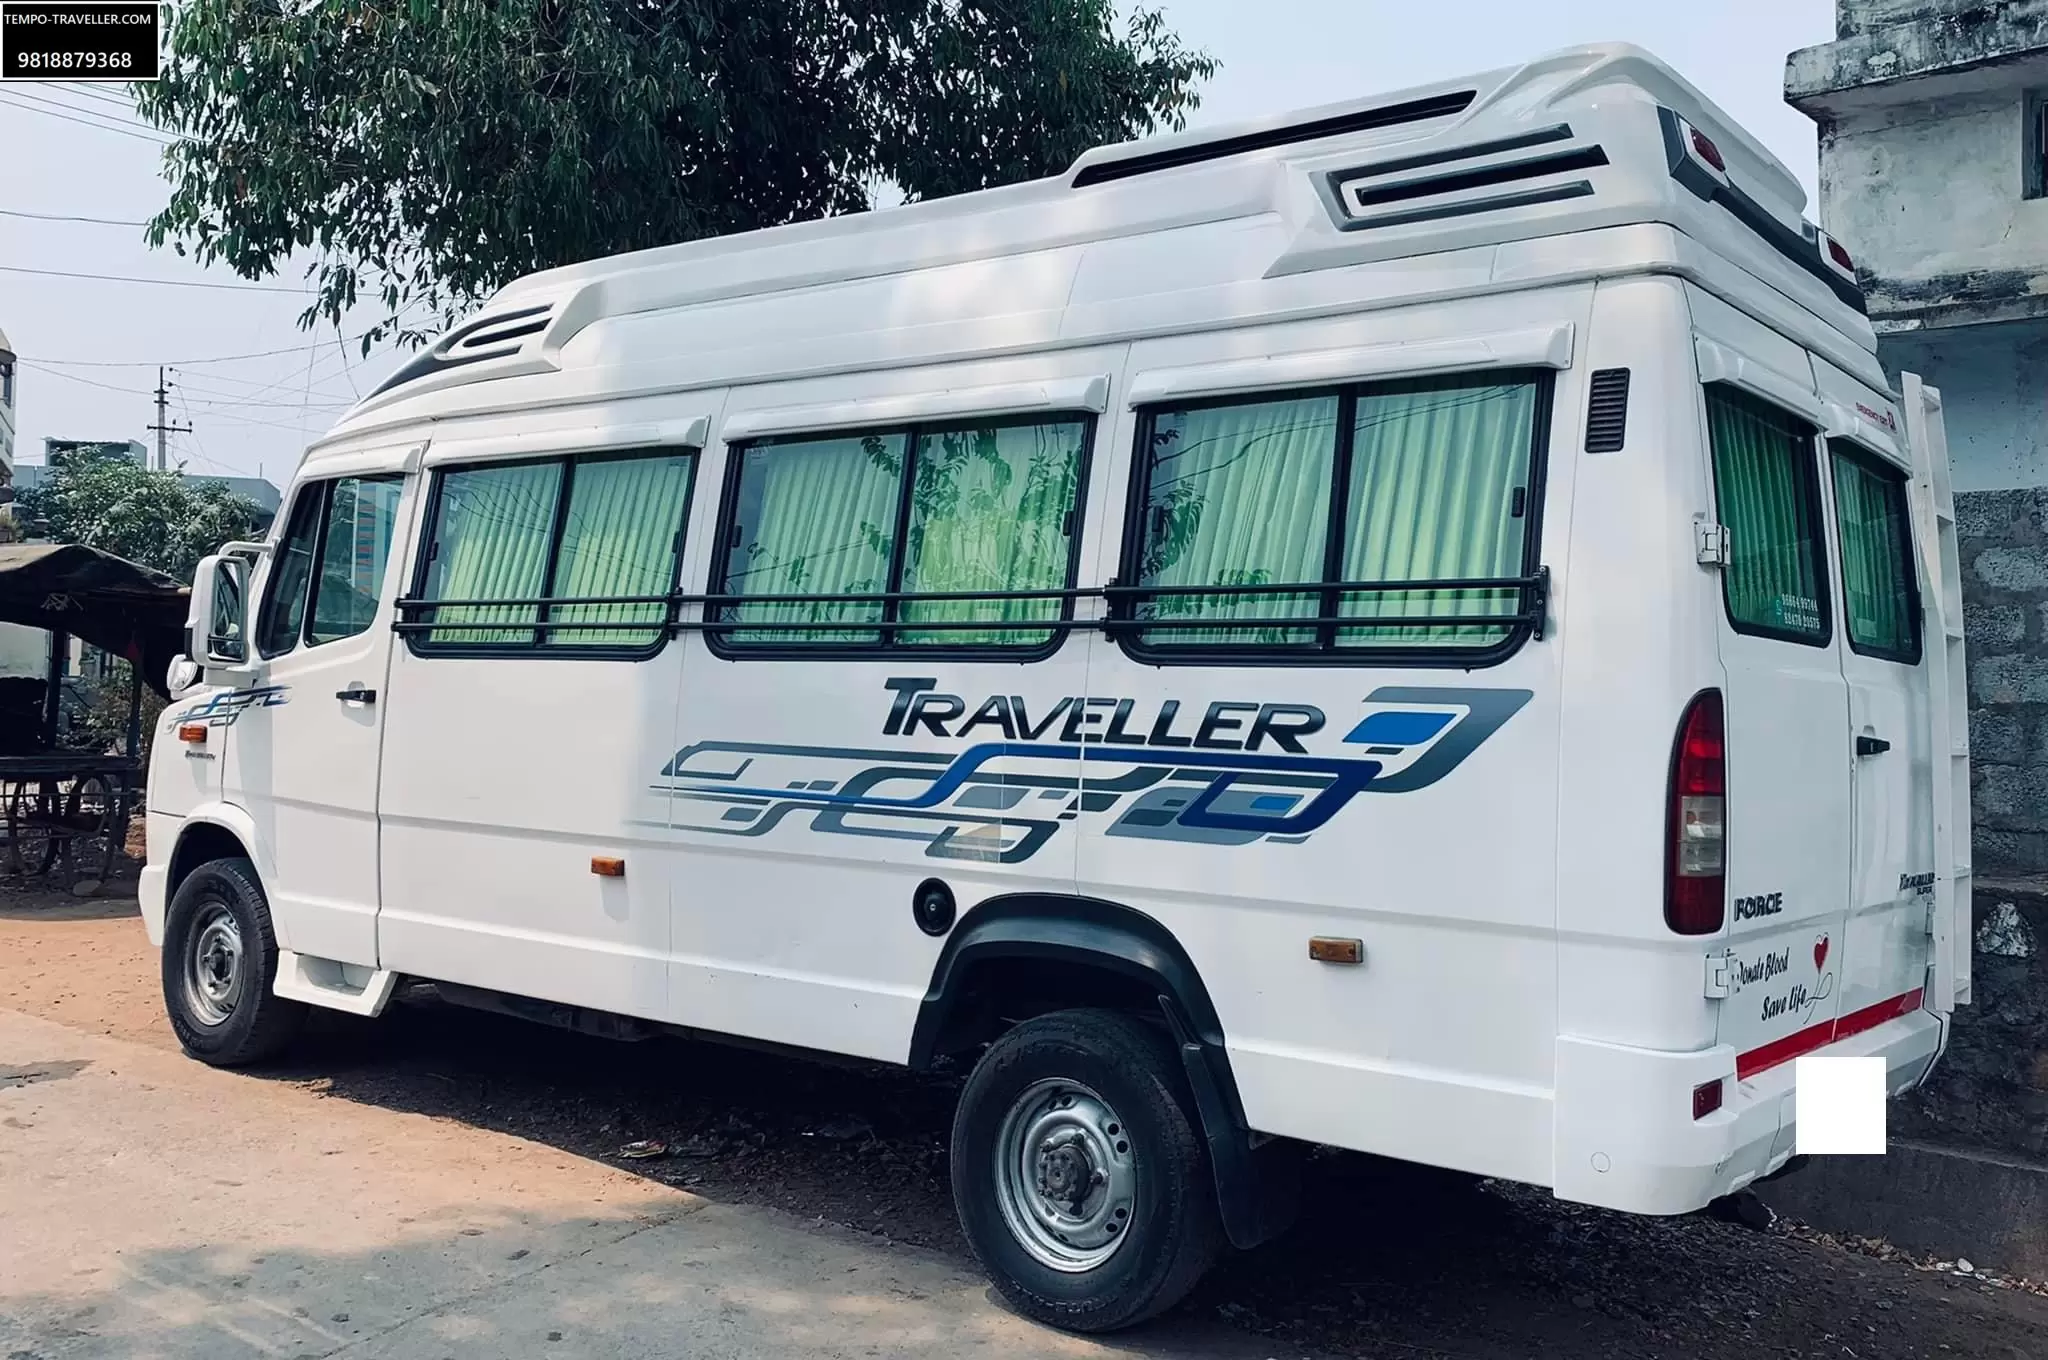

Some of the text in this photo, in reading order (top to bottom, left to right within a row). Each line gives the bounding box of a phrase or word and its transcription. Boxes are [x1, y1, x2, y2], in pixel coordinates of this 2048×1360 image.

[1734, 892, 1782, 921] FORCE
[1765, 946, 1789, 982] Blood
[1761, 995, 1787, 1021] Save
